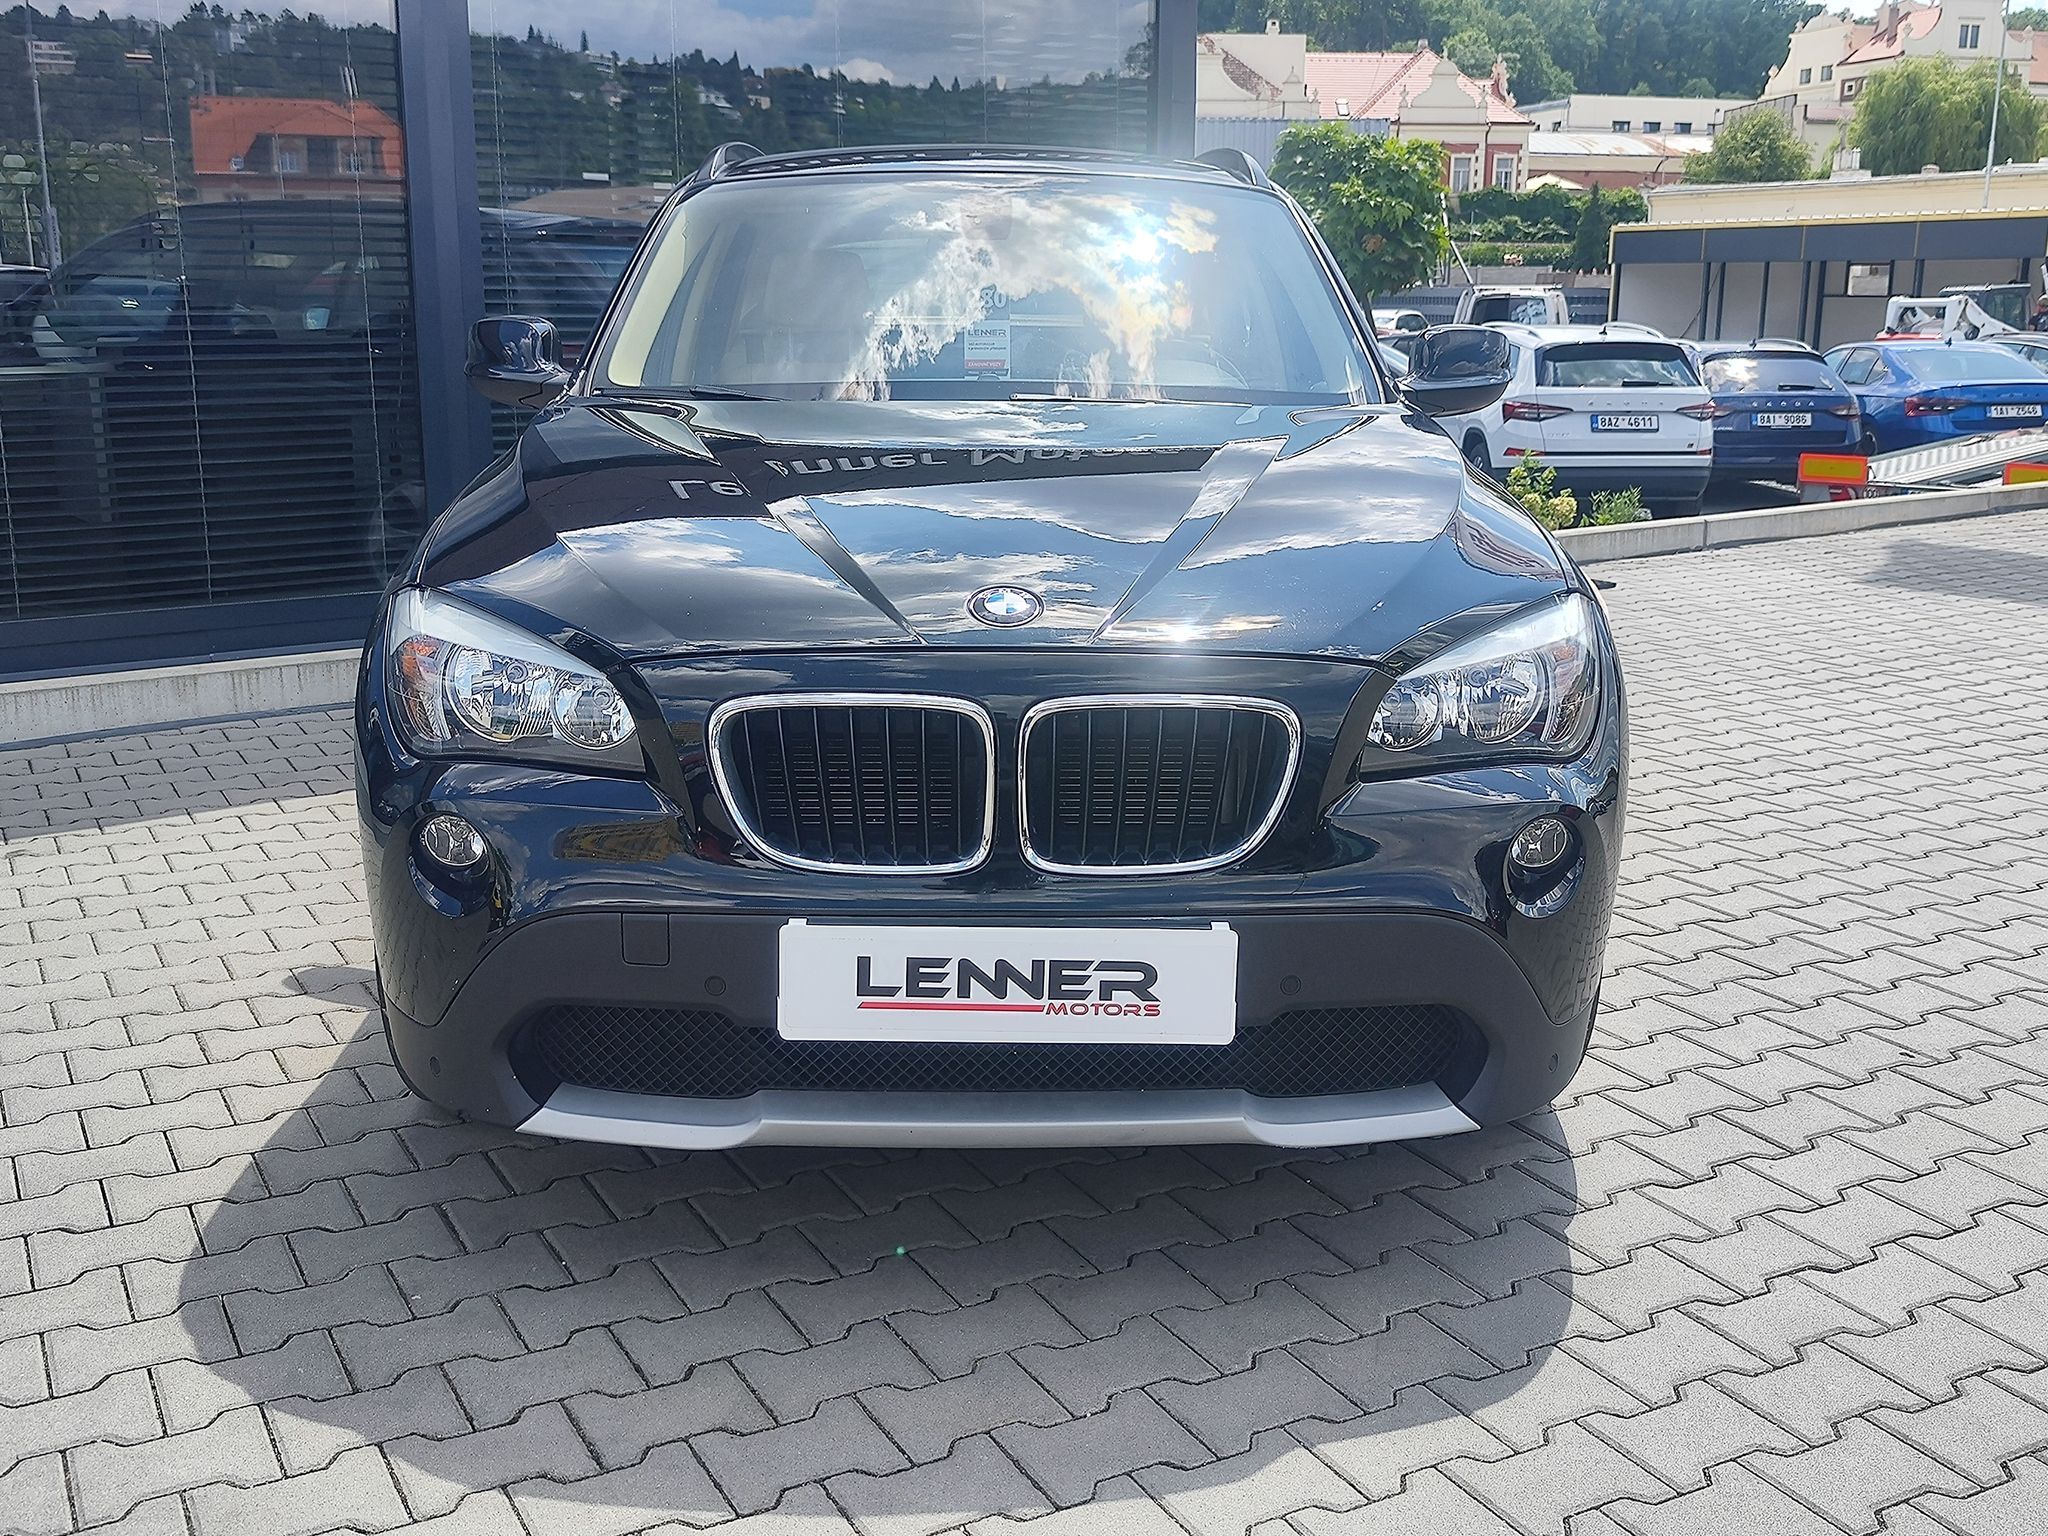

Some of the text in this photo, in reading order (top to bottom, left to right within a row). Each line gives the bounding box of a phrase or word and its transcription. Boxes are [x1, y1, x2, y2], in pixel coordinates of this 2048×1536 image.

[967, 329, 1007, 337] LENNER
[1600, 416, 1652, 428] 8AZ 4611
[1759, 414, 1807, 425] 8AI 9086
[857, 956, 1161, 1002] LENNER
[1046, 1003, 1161, 1017] MOTORS
